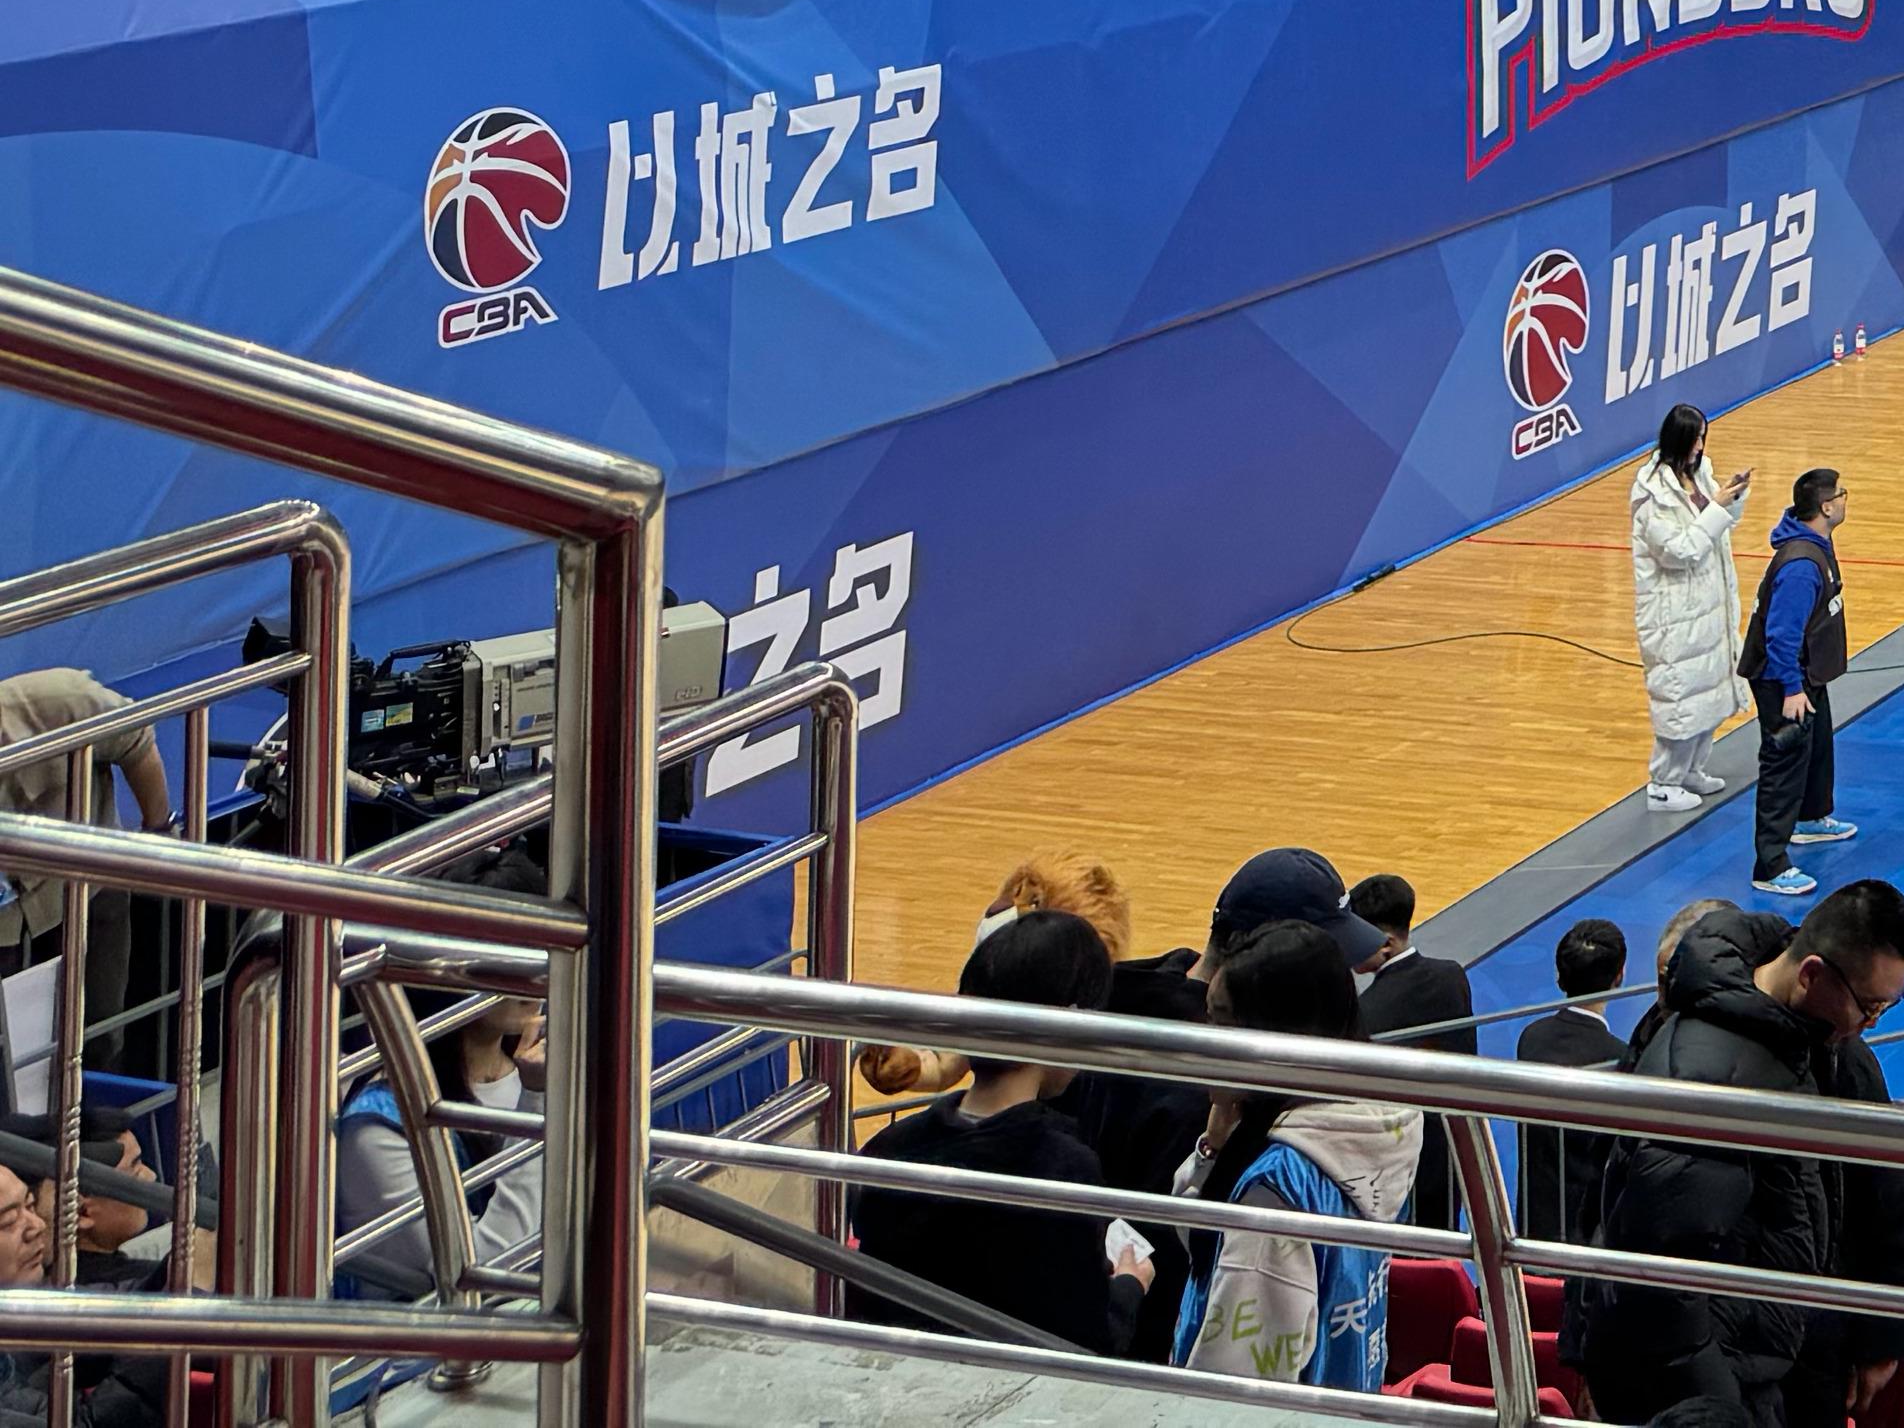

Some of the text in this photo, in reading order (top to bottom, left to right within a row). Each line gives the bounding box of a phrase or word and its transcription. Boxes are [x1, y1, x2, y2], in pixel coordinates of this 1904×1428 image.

[599, 63, 942, 291] 以城之名
[438, 286, 559, 349] CBA
[1605, 186, 1818, 404] 以城之名
[1512, 400, 1582, 461] CBA
